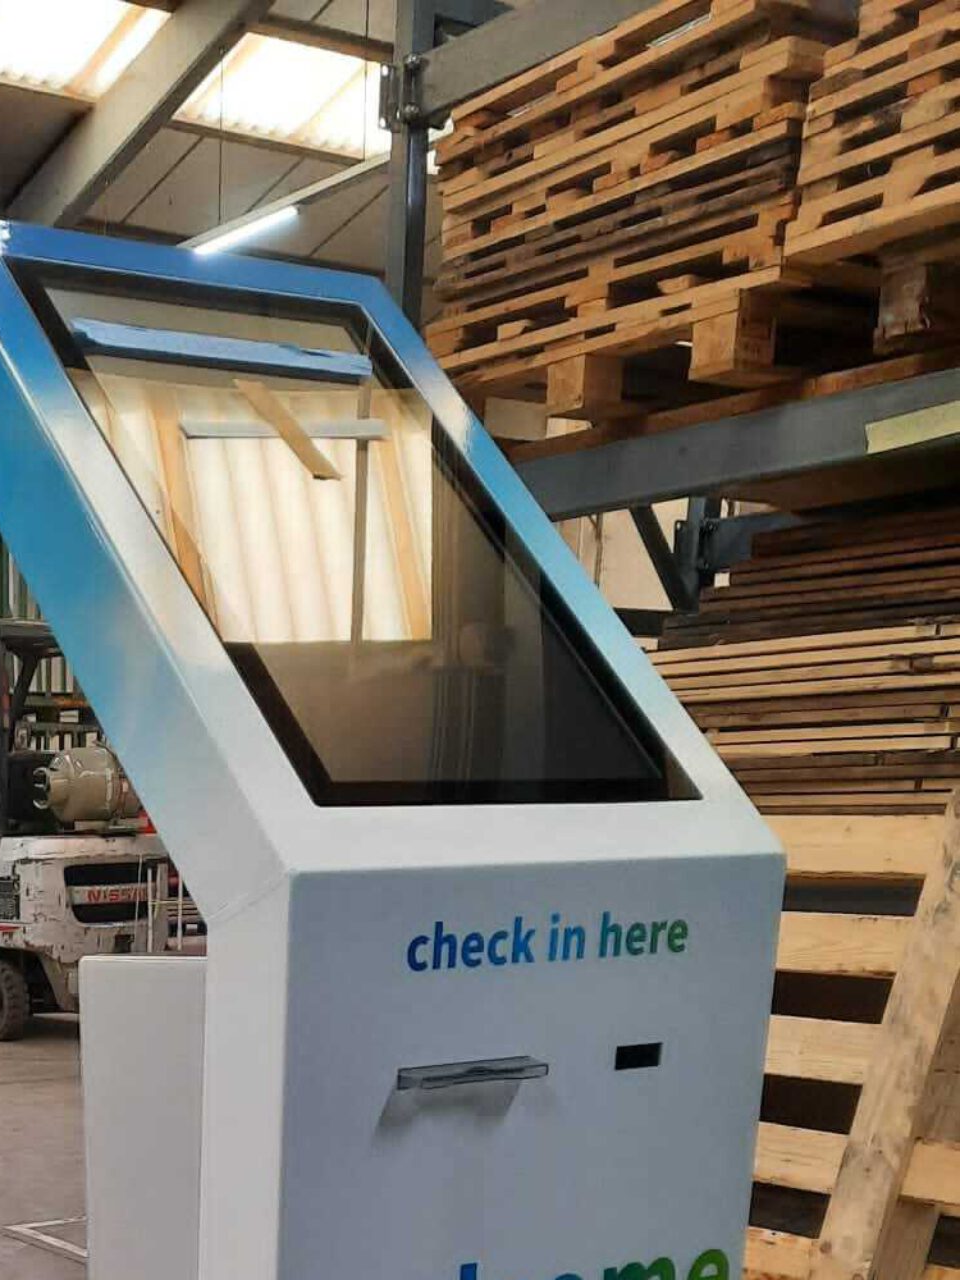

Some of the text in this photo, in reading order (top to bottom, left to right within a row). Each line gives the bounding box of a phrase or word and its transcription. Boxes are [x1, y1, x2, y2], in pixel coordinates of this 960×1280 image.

[406, 911, 689, 972] check in here
